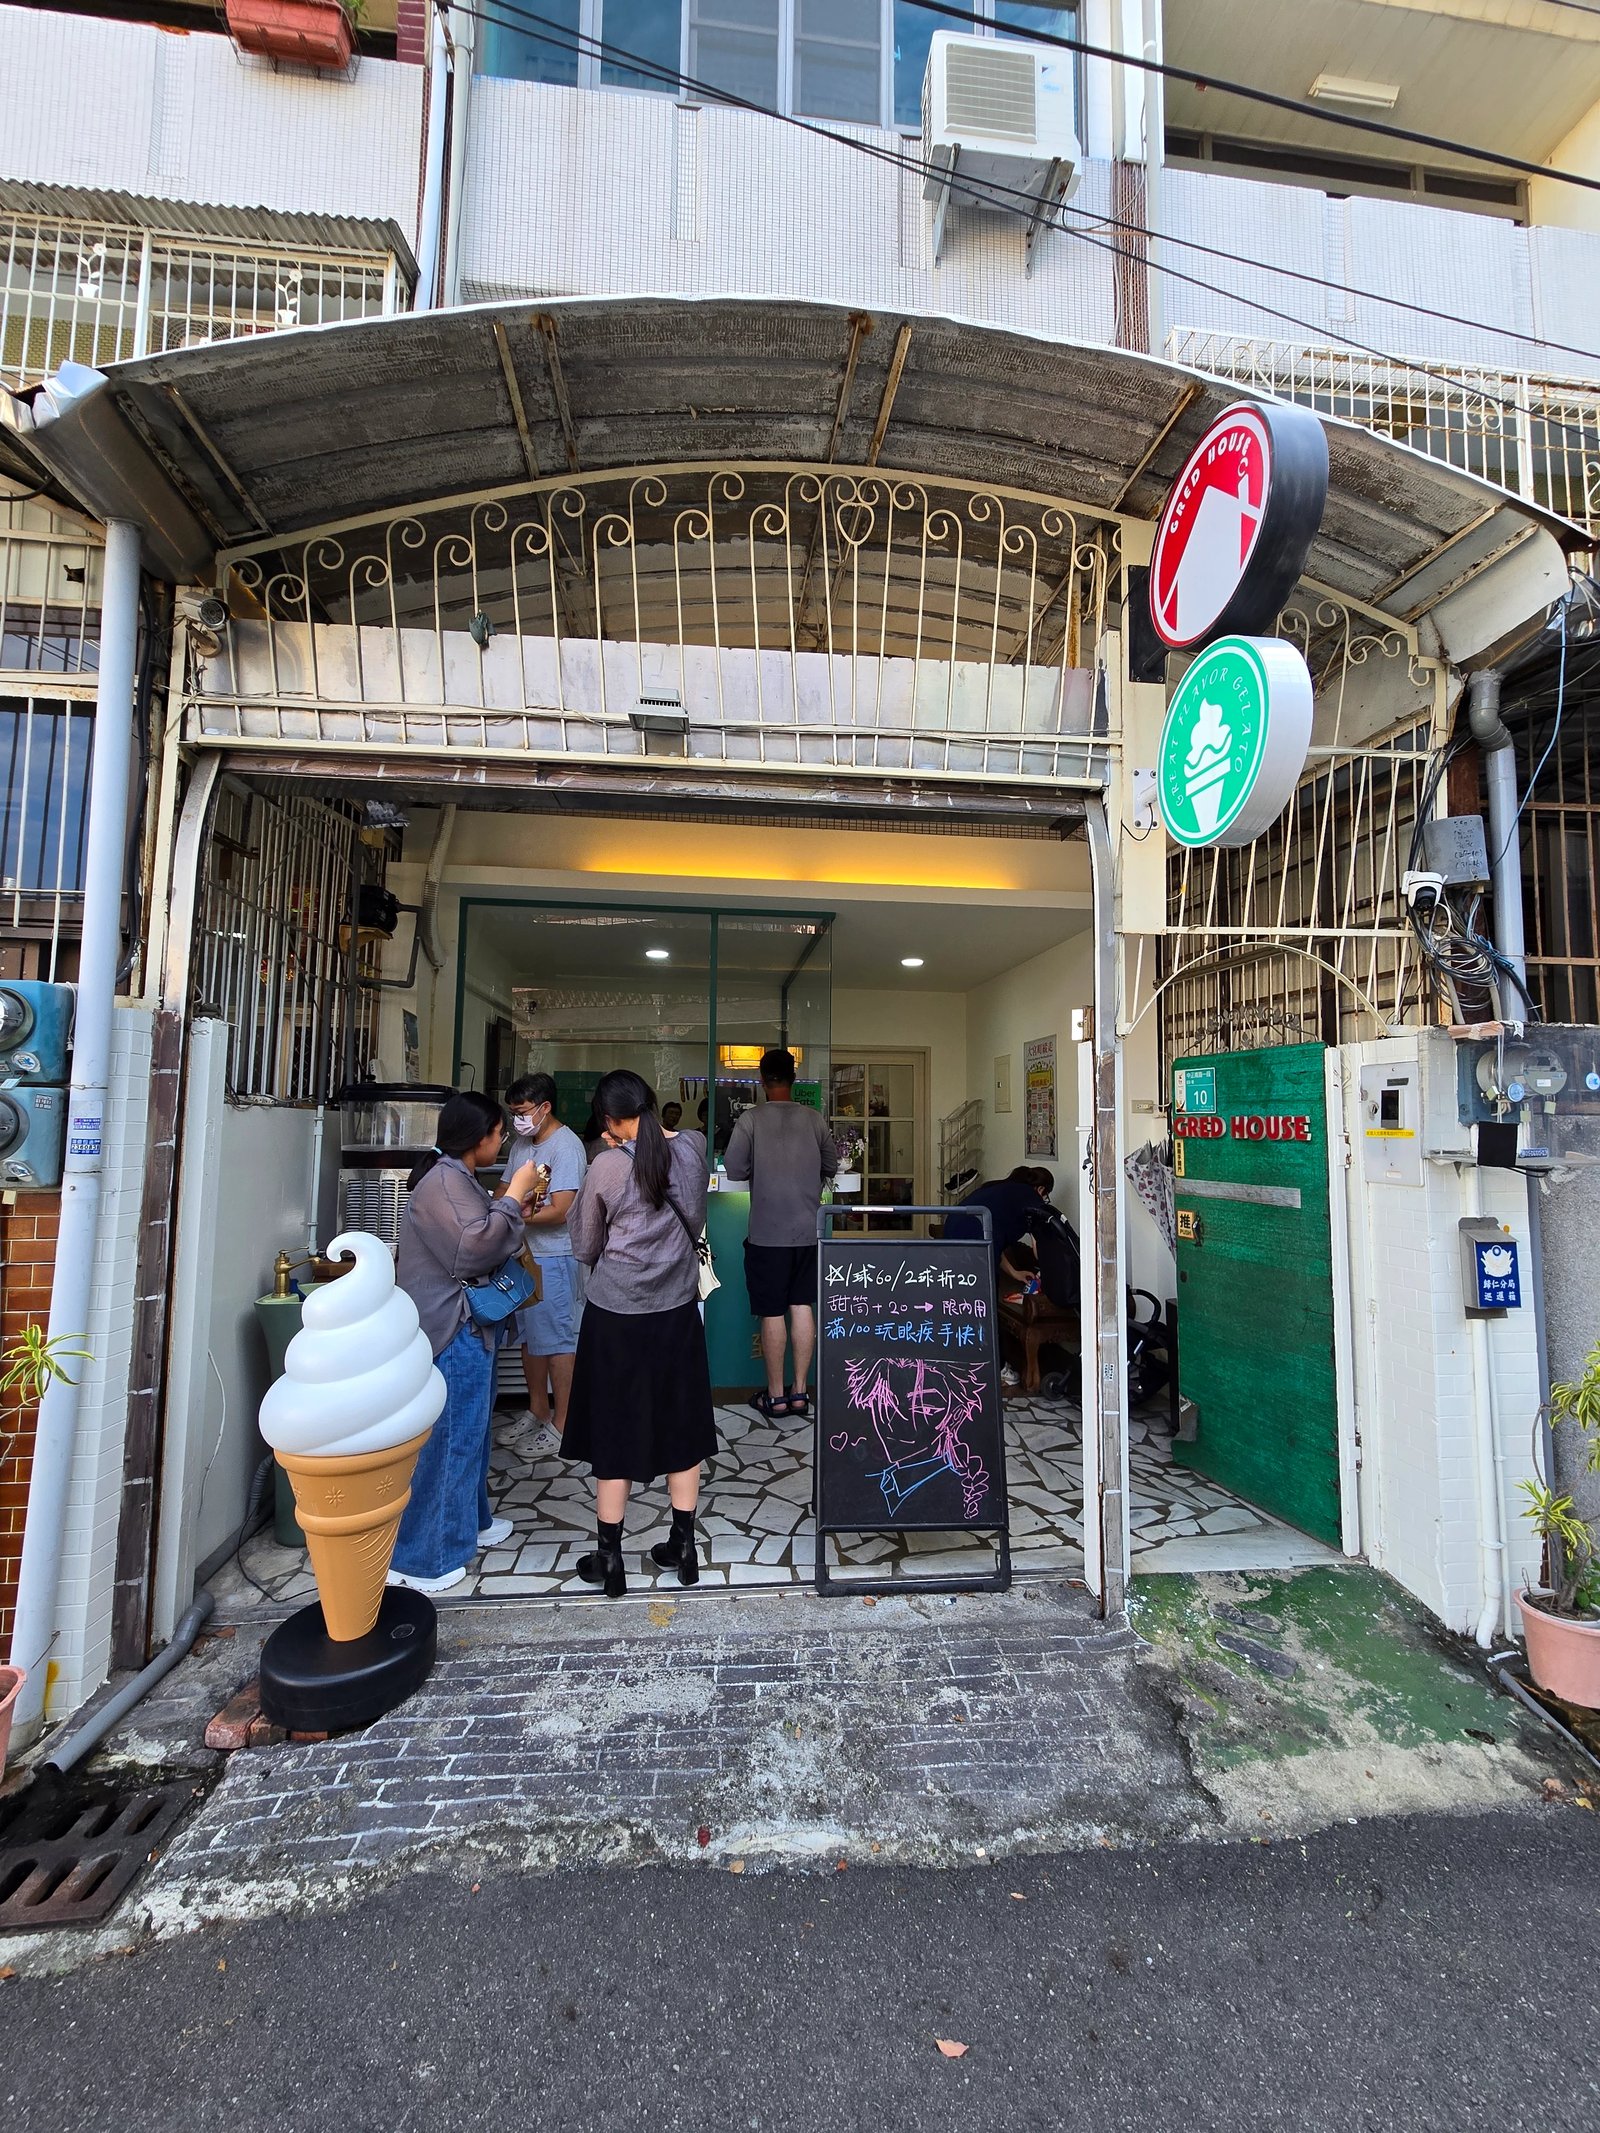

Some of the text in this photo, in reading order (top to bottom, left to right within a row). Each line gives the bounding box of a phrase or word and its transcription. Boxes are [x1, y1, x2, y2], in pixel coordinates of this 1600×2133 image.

[1170, 432, 1252, 533] GRED HOUSE
[1169, 667, 1251, 806] GREAT FLAVOR GELATO
[794, 1089, 816, 1097] Uber
[1193, 1090, 1207, 1105] 10
[794, 1097, 816, 1106] Eats
[1173, 1115, 1312, 1141] GRED HOUSE
[1180, 1213, 1191, 1229] 推
[1179, 1228, 1192, 1236] PUSH
[1483, 1279, 1516, 1289] 歸仁分局
